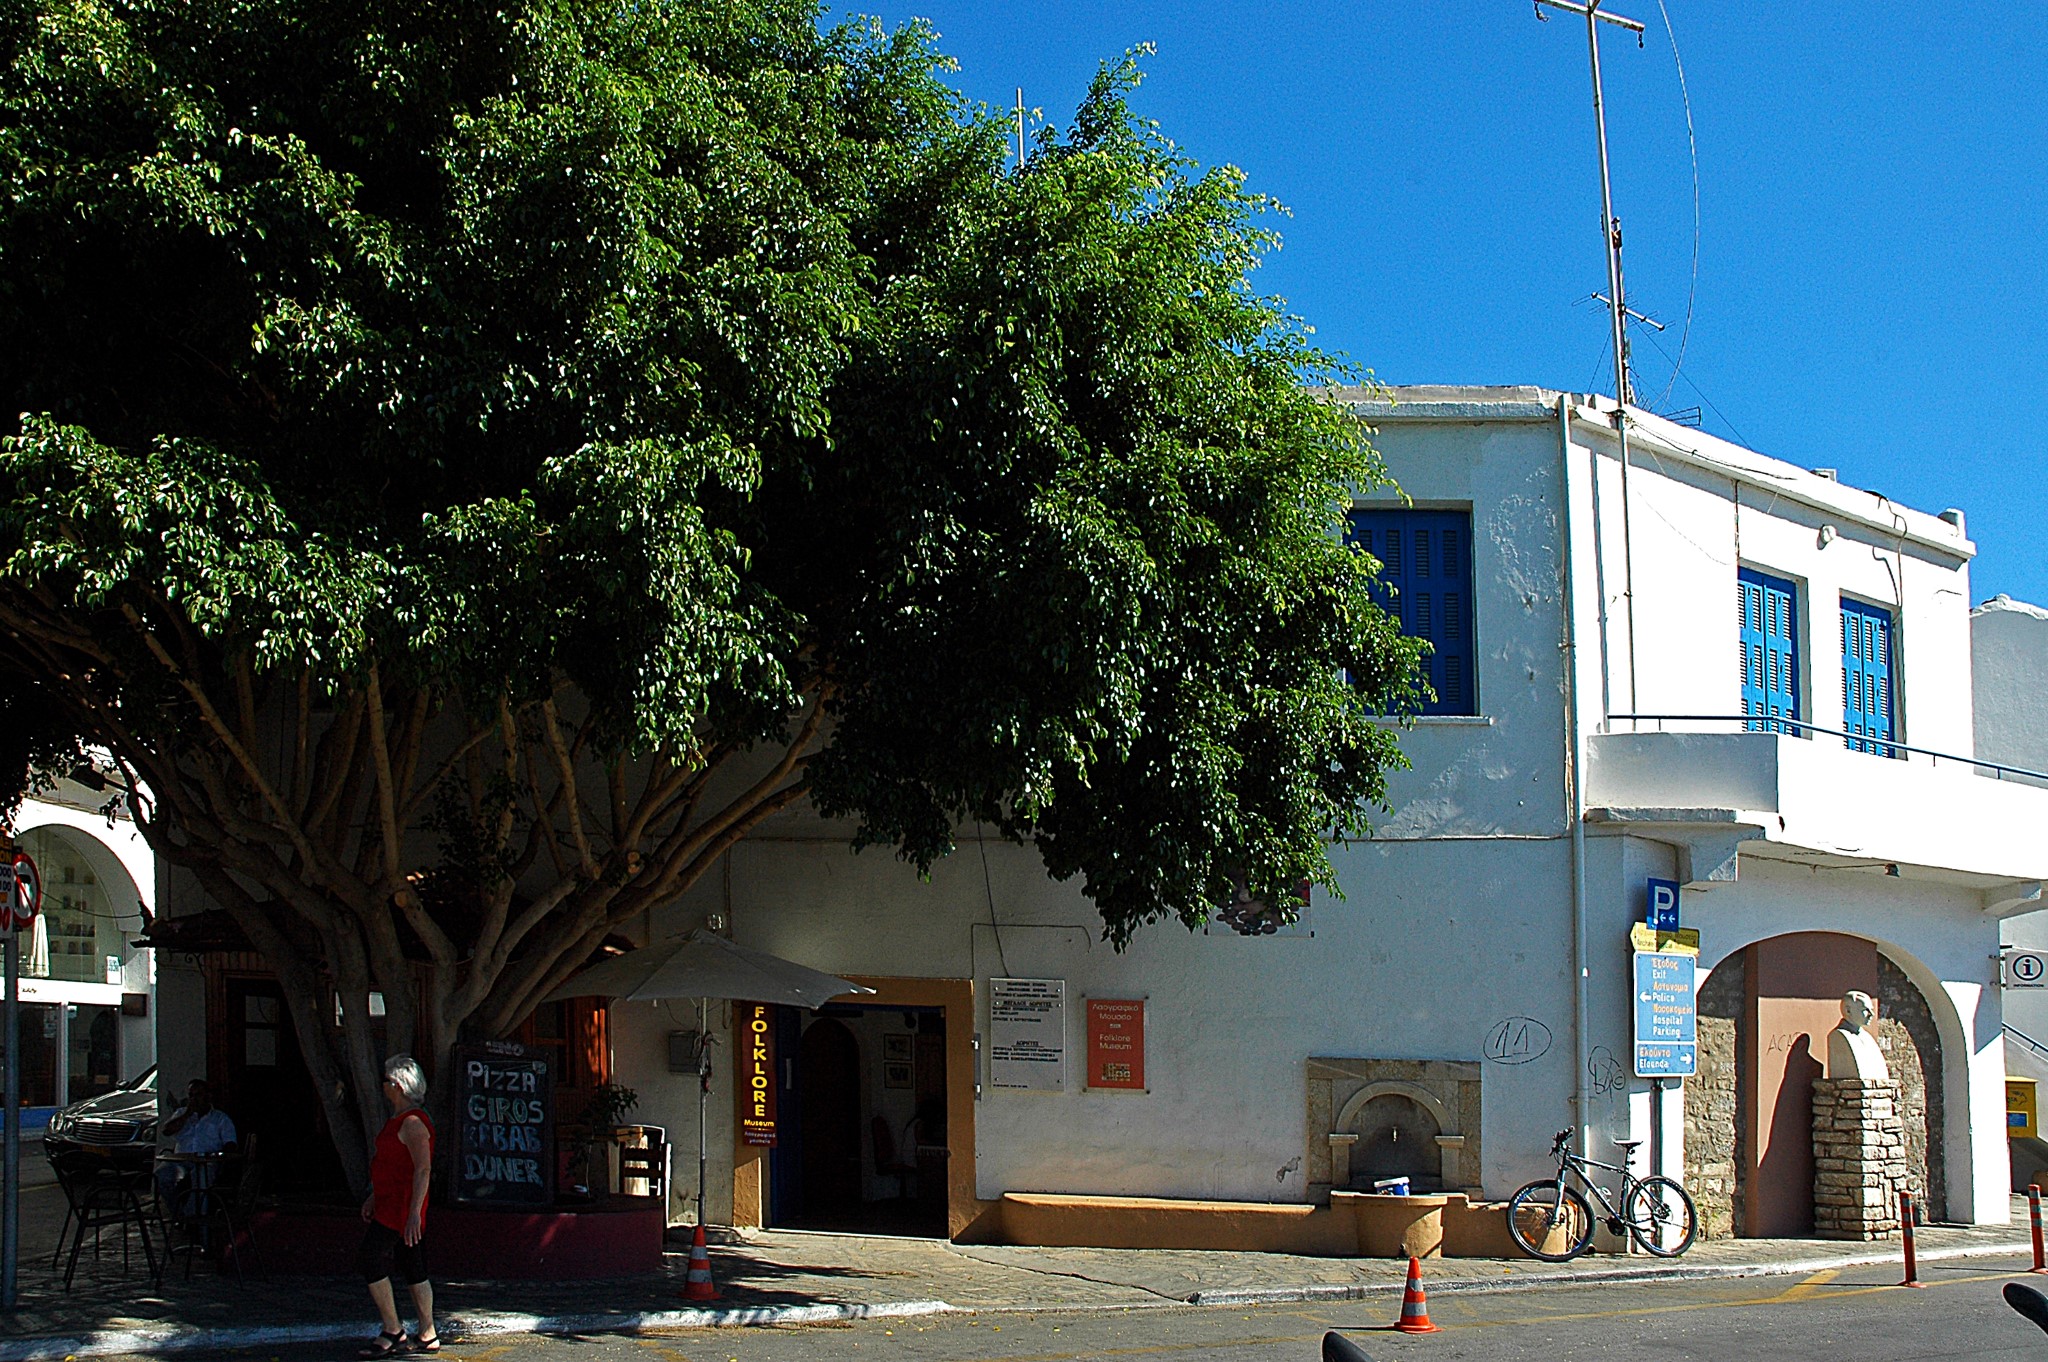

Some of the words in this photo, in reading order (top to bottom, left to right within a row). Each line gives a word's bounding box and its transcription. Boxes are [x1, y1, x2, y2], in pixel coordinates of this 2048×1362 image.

[1653, 886, 1674, 925] P
[1652, 969, 1666, 979] Exit
[1652, 992, 1675, 1003] Police
[1652, 1015, 1683, 1026] Hospital
[1099, 1033, 1131, 1042] Folklore
[1652, 1026, 1681, 1039] Parking
[1099, 1042, 1132, 1051] Museum
[751, 1006, 768, 1117] FOLKLORE
[1639, 1058, 1670, 1069] Elounda
[468, 1094, 545, 1124] GIROS
[743, 1119, 775, 1127] Museum
